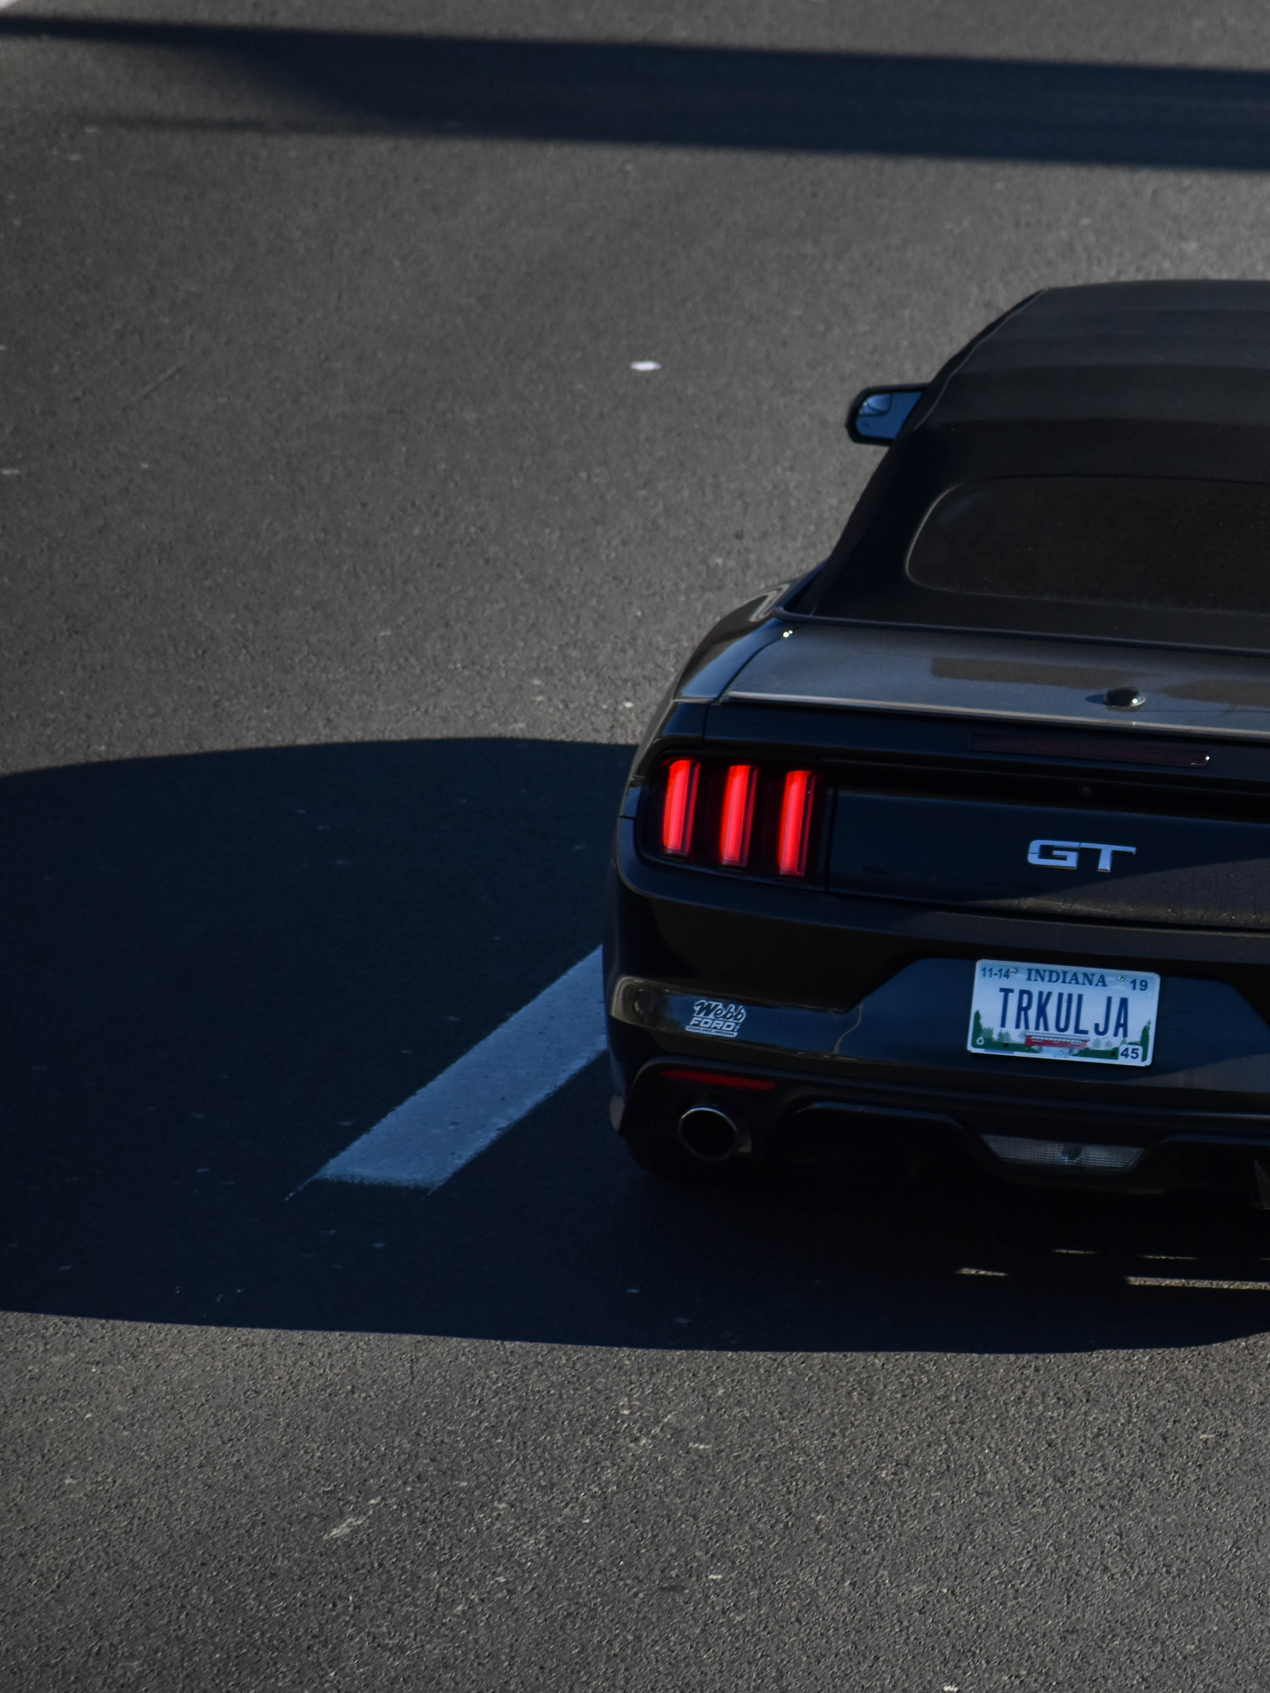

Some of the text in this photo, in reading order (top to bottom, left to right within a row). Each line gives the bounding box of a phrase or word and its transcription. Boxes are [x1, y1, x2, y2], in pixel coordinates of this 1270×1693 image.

[1027, 839, 1136, 873] GT
[981, 966, 1148, 991] 11-14 INDIANA 19
[694, 1000, 746, 1022] Webb
[690, 1018, 736, 1030] FORD
[1120, 1047, 1139, 1060] 45
